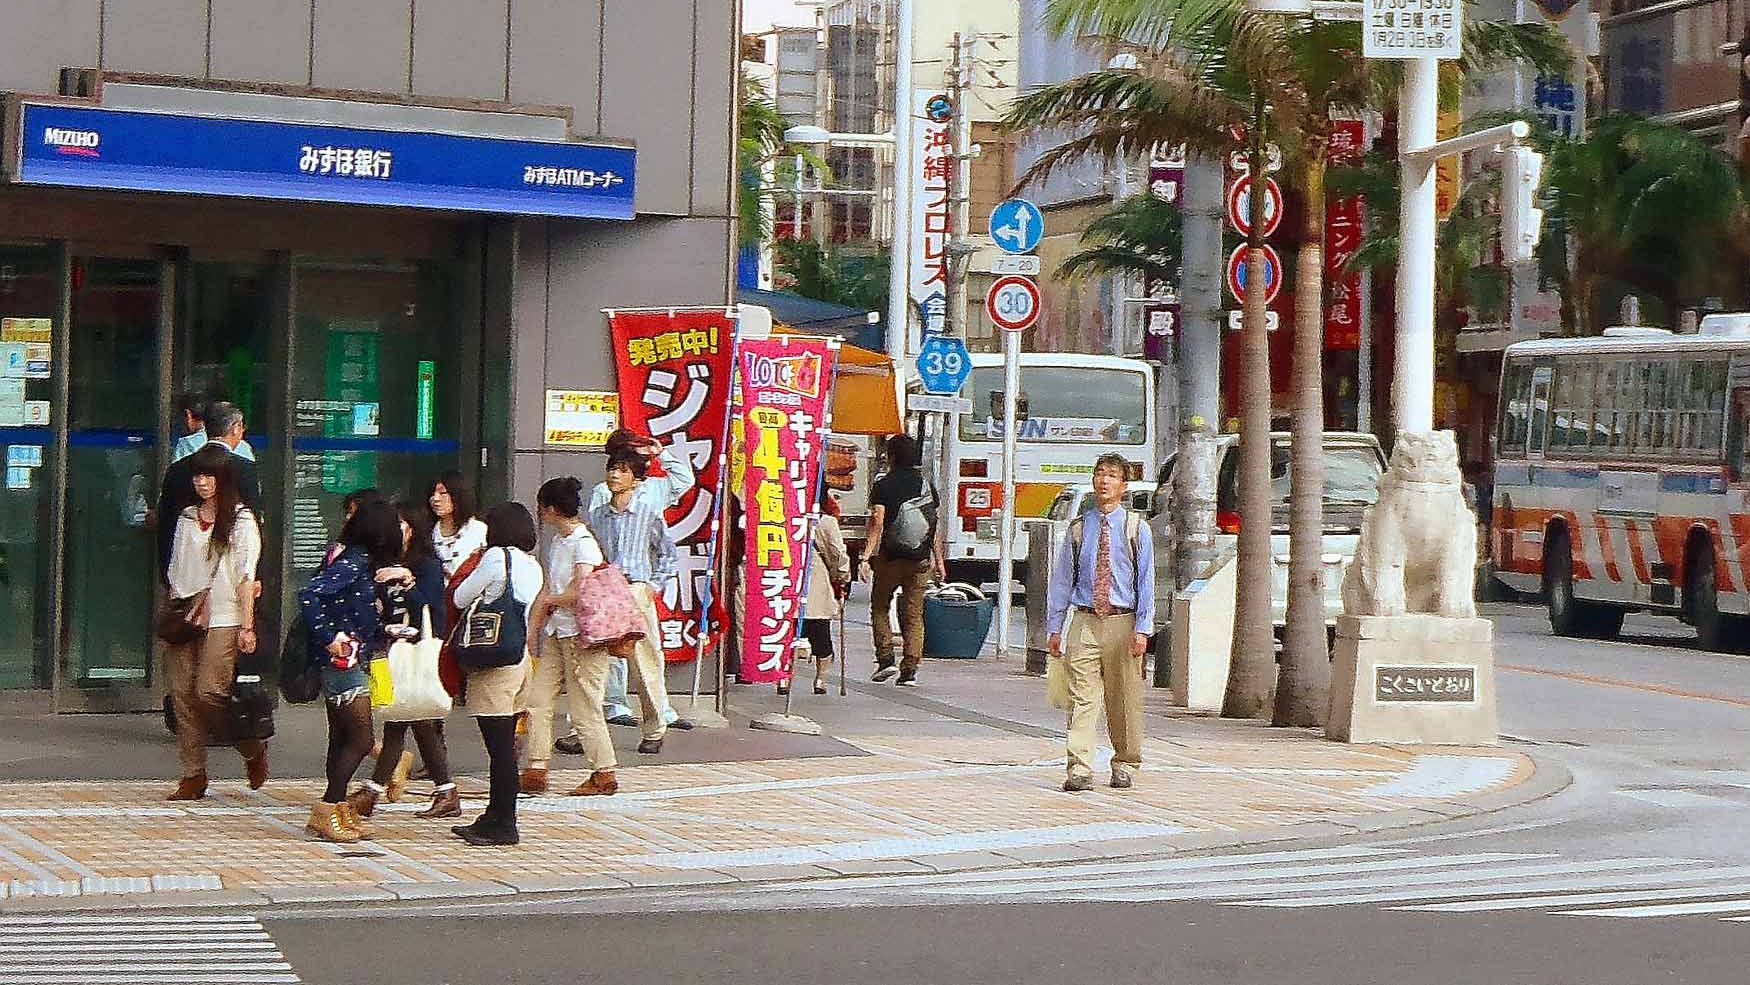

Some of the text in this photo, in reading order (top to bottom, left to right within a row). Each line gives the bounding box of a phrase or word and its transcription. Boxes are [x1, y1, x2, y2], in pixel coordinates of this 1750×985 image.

[300, 146, 391, 177] みずほ銀行
[1000, 291, 1029, 315] 30
[926, 351, 962, 375] 39
[969, 490, 987, 505] 25
